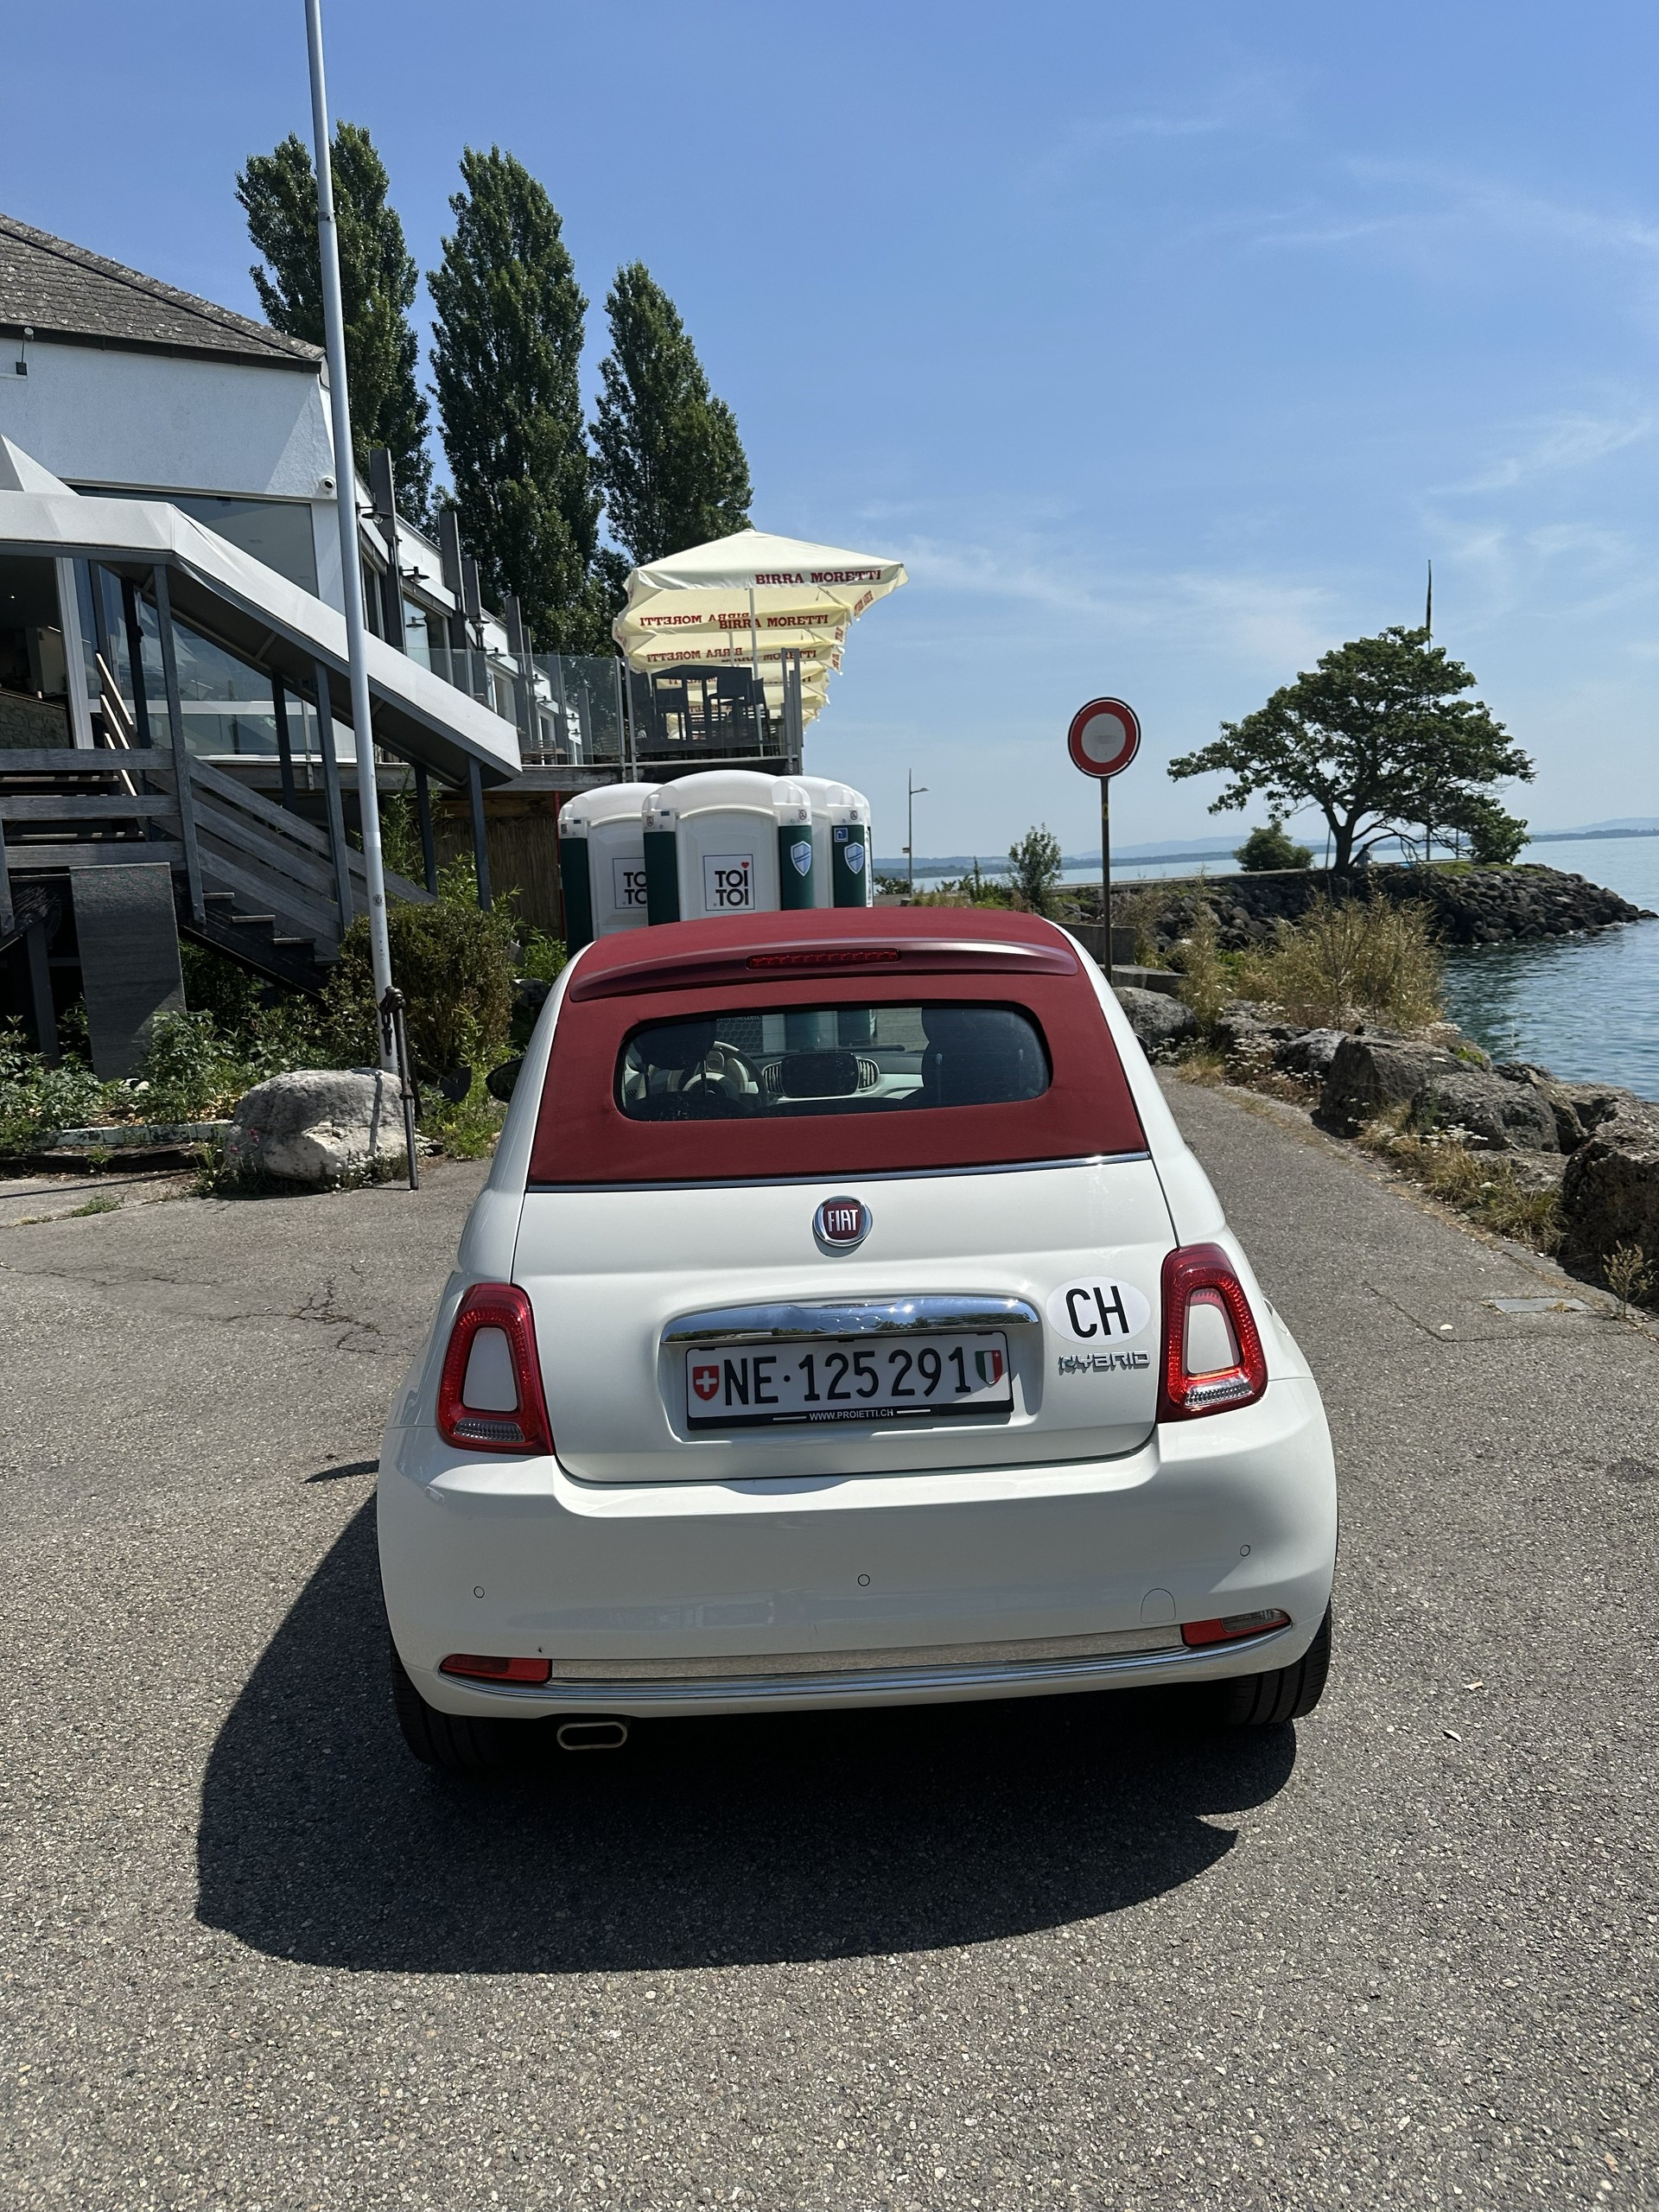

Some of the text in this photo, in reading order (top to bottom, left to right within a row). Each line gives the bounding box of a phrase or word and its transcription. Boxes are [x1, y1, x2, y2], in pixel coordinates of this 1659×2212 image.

[754, 569, 882, 585] BIRRA MORETTI
[766, 614, 829, 628] MORETTI
[623, 871, 646, 888] TO
[715, 869, 749, 888] TOI
[624, 888, 647, 905] TO
[715, 888, 750, 906] TOI
[827, 1209, 859, 1232] FIAT
[1065, 1285, 1130, 1338] CH
[1058, 1350, 1151, 1370] HYBRID
[809, 1408, 893, 1421] WWW.PROIETTI.CH
